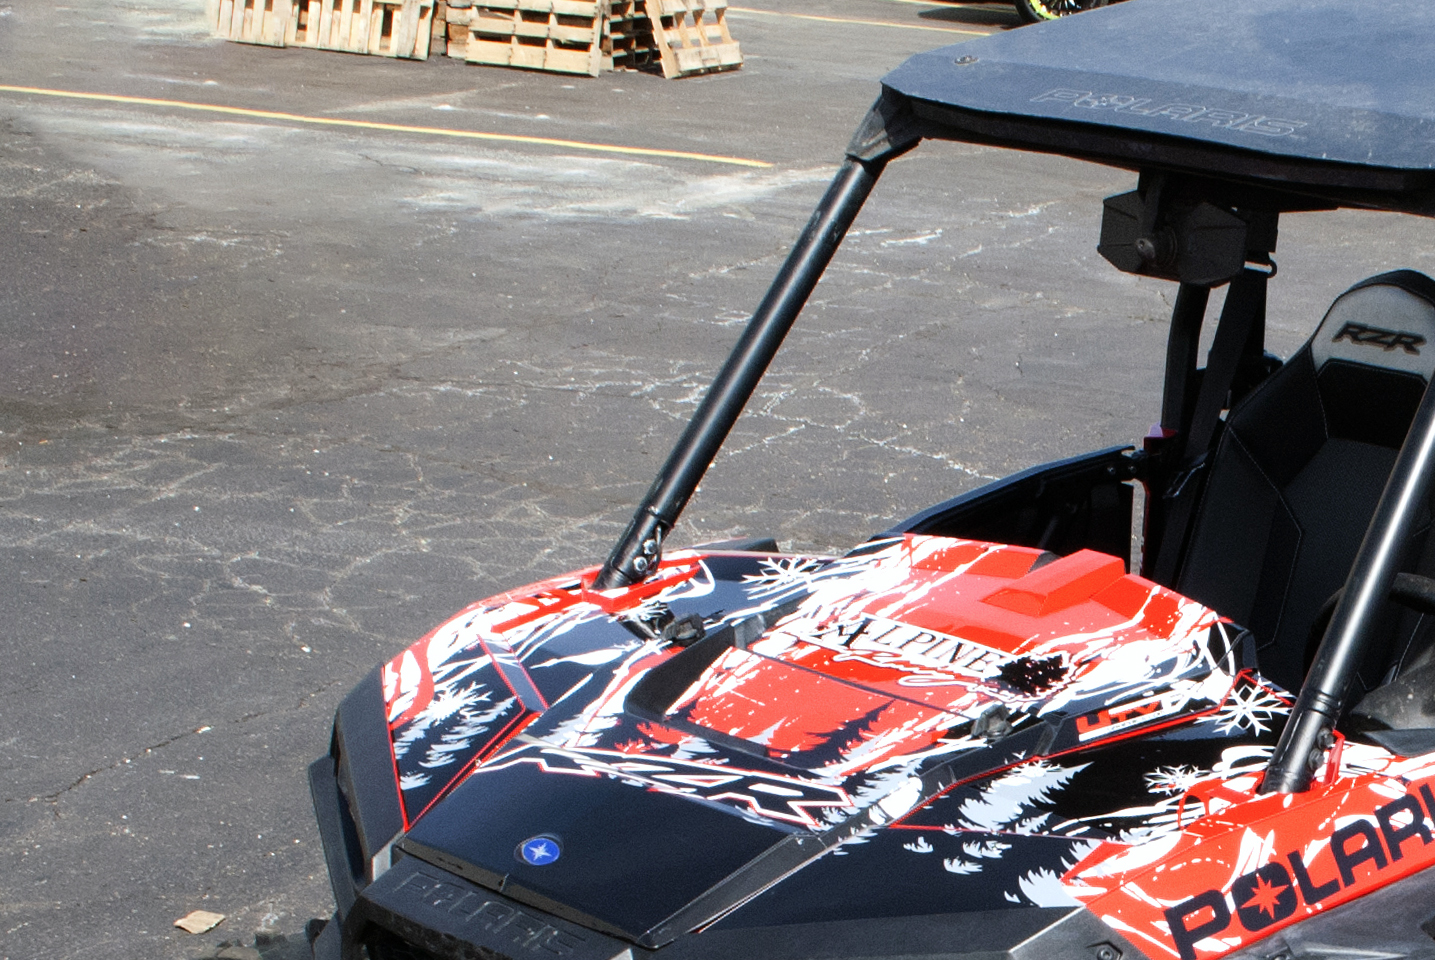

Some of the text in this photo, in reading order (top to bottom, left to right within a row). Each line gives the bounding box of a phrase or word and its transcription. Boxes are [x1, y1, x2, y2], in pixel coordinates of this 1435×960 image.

[1030, 88, 1308, 137] POLARIS
[1332, 321, 1427, 355] RZR
[809, 617, 1004, 673] ALPINE
[390, 871, 590, 957] POLARIS
